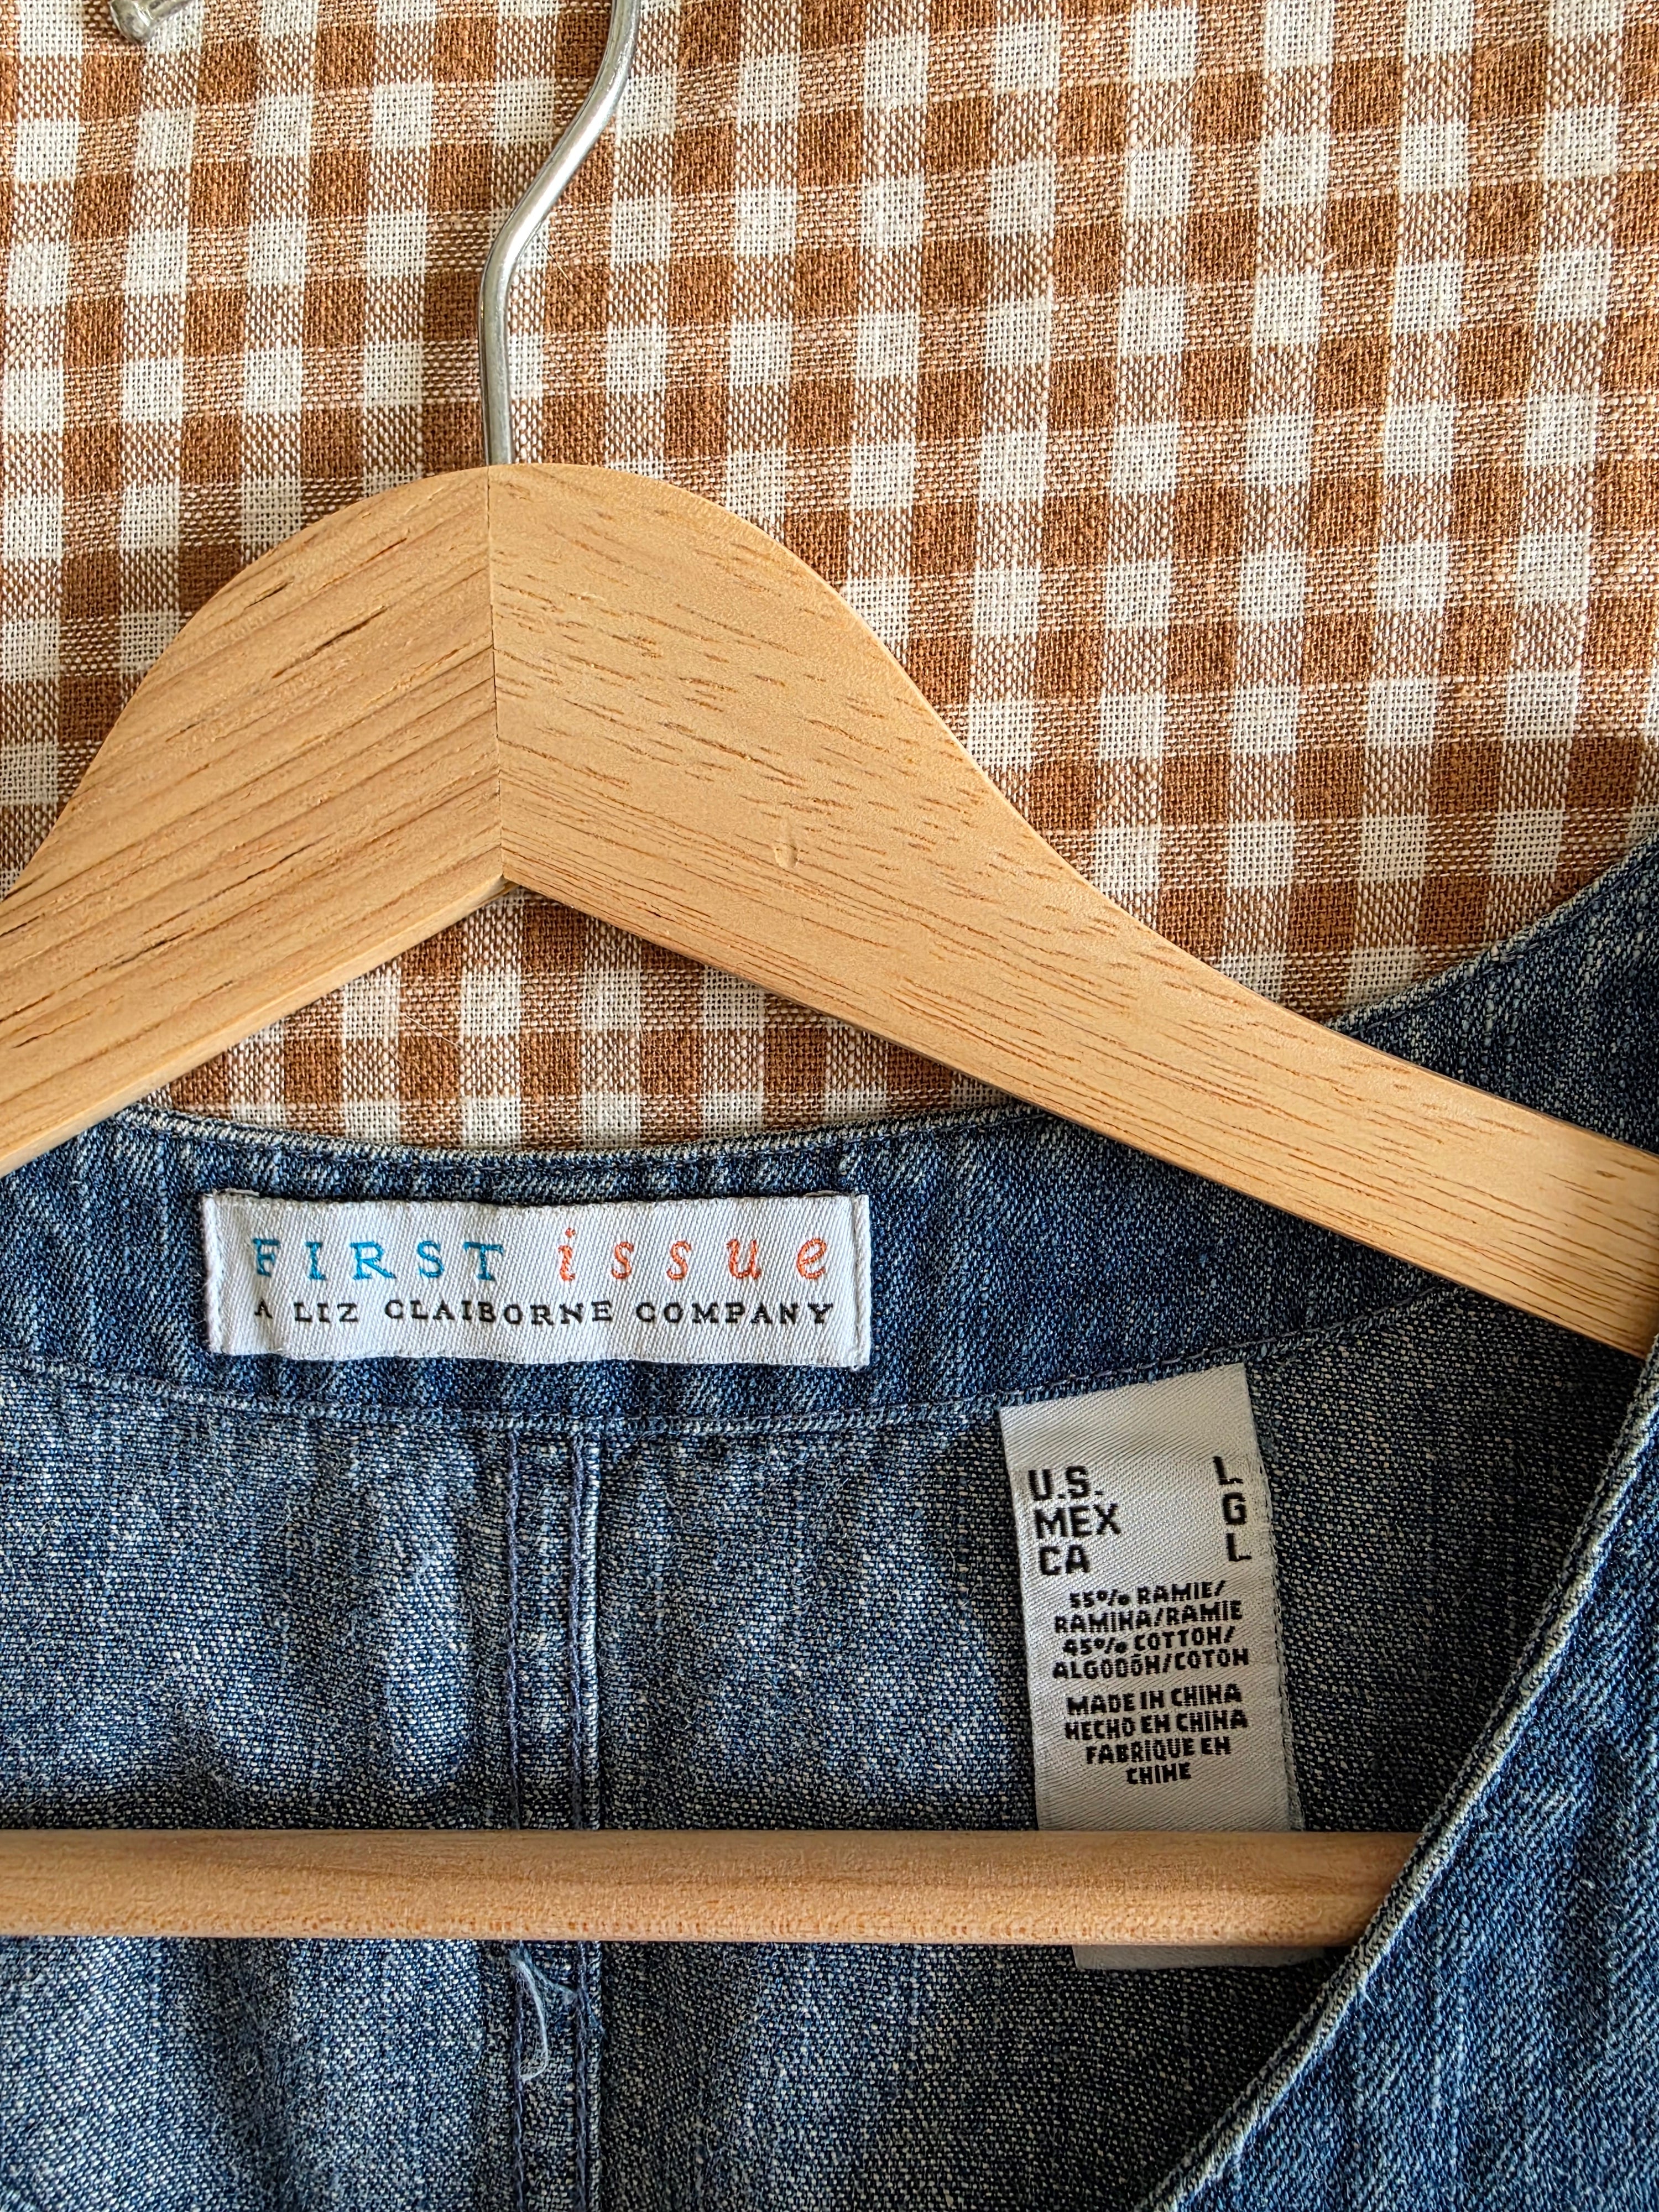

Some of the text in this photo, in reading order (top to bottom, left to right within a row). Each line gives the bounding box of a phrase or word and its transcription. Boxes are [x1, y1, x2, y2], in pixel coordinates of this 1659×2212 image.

[252, 1227, 828, 1282] FIRST issue
[253, 1297, 834, 1326] A LIZ CLAIBORNE COMPANY
[1028, 1456, 1243, 1500] U.S. L
[1034, 1492, 1246, 1538] MEX G
[1039, 1533, 1252, 1575] CA L
[1069, 1588, 1131, 1608] 55%
[1063, 1637, 1129, 1656] 45%
[1066, 1683, 1242, 1714] MADE IN CHINA
[1065, 1709, 1248, 1740] HECHO EN CHINA
[1086, 1736, 1232, 1764] FABRIQUE EN
[1126, 1762, 1192, 1785] CHINE
